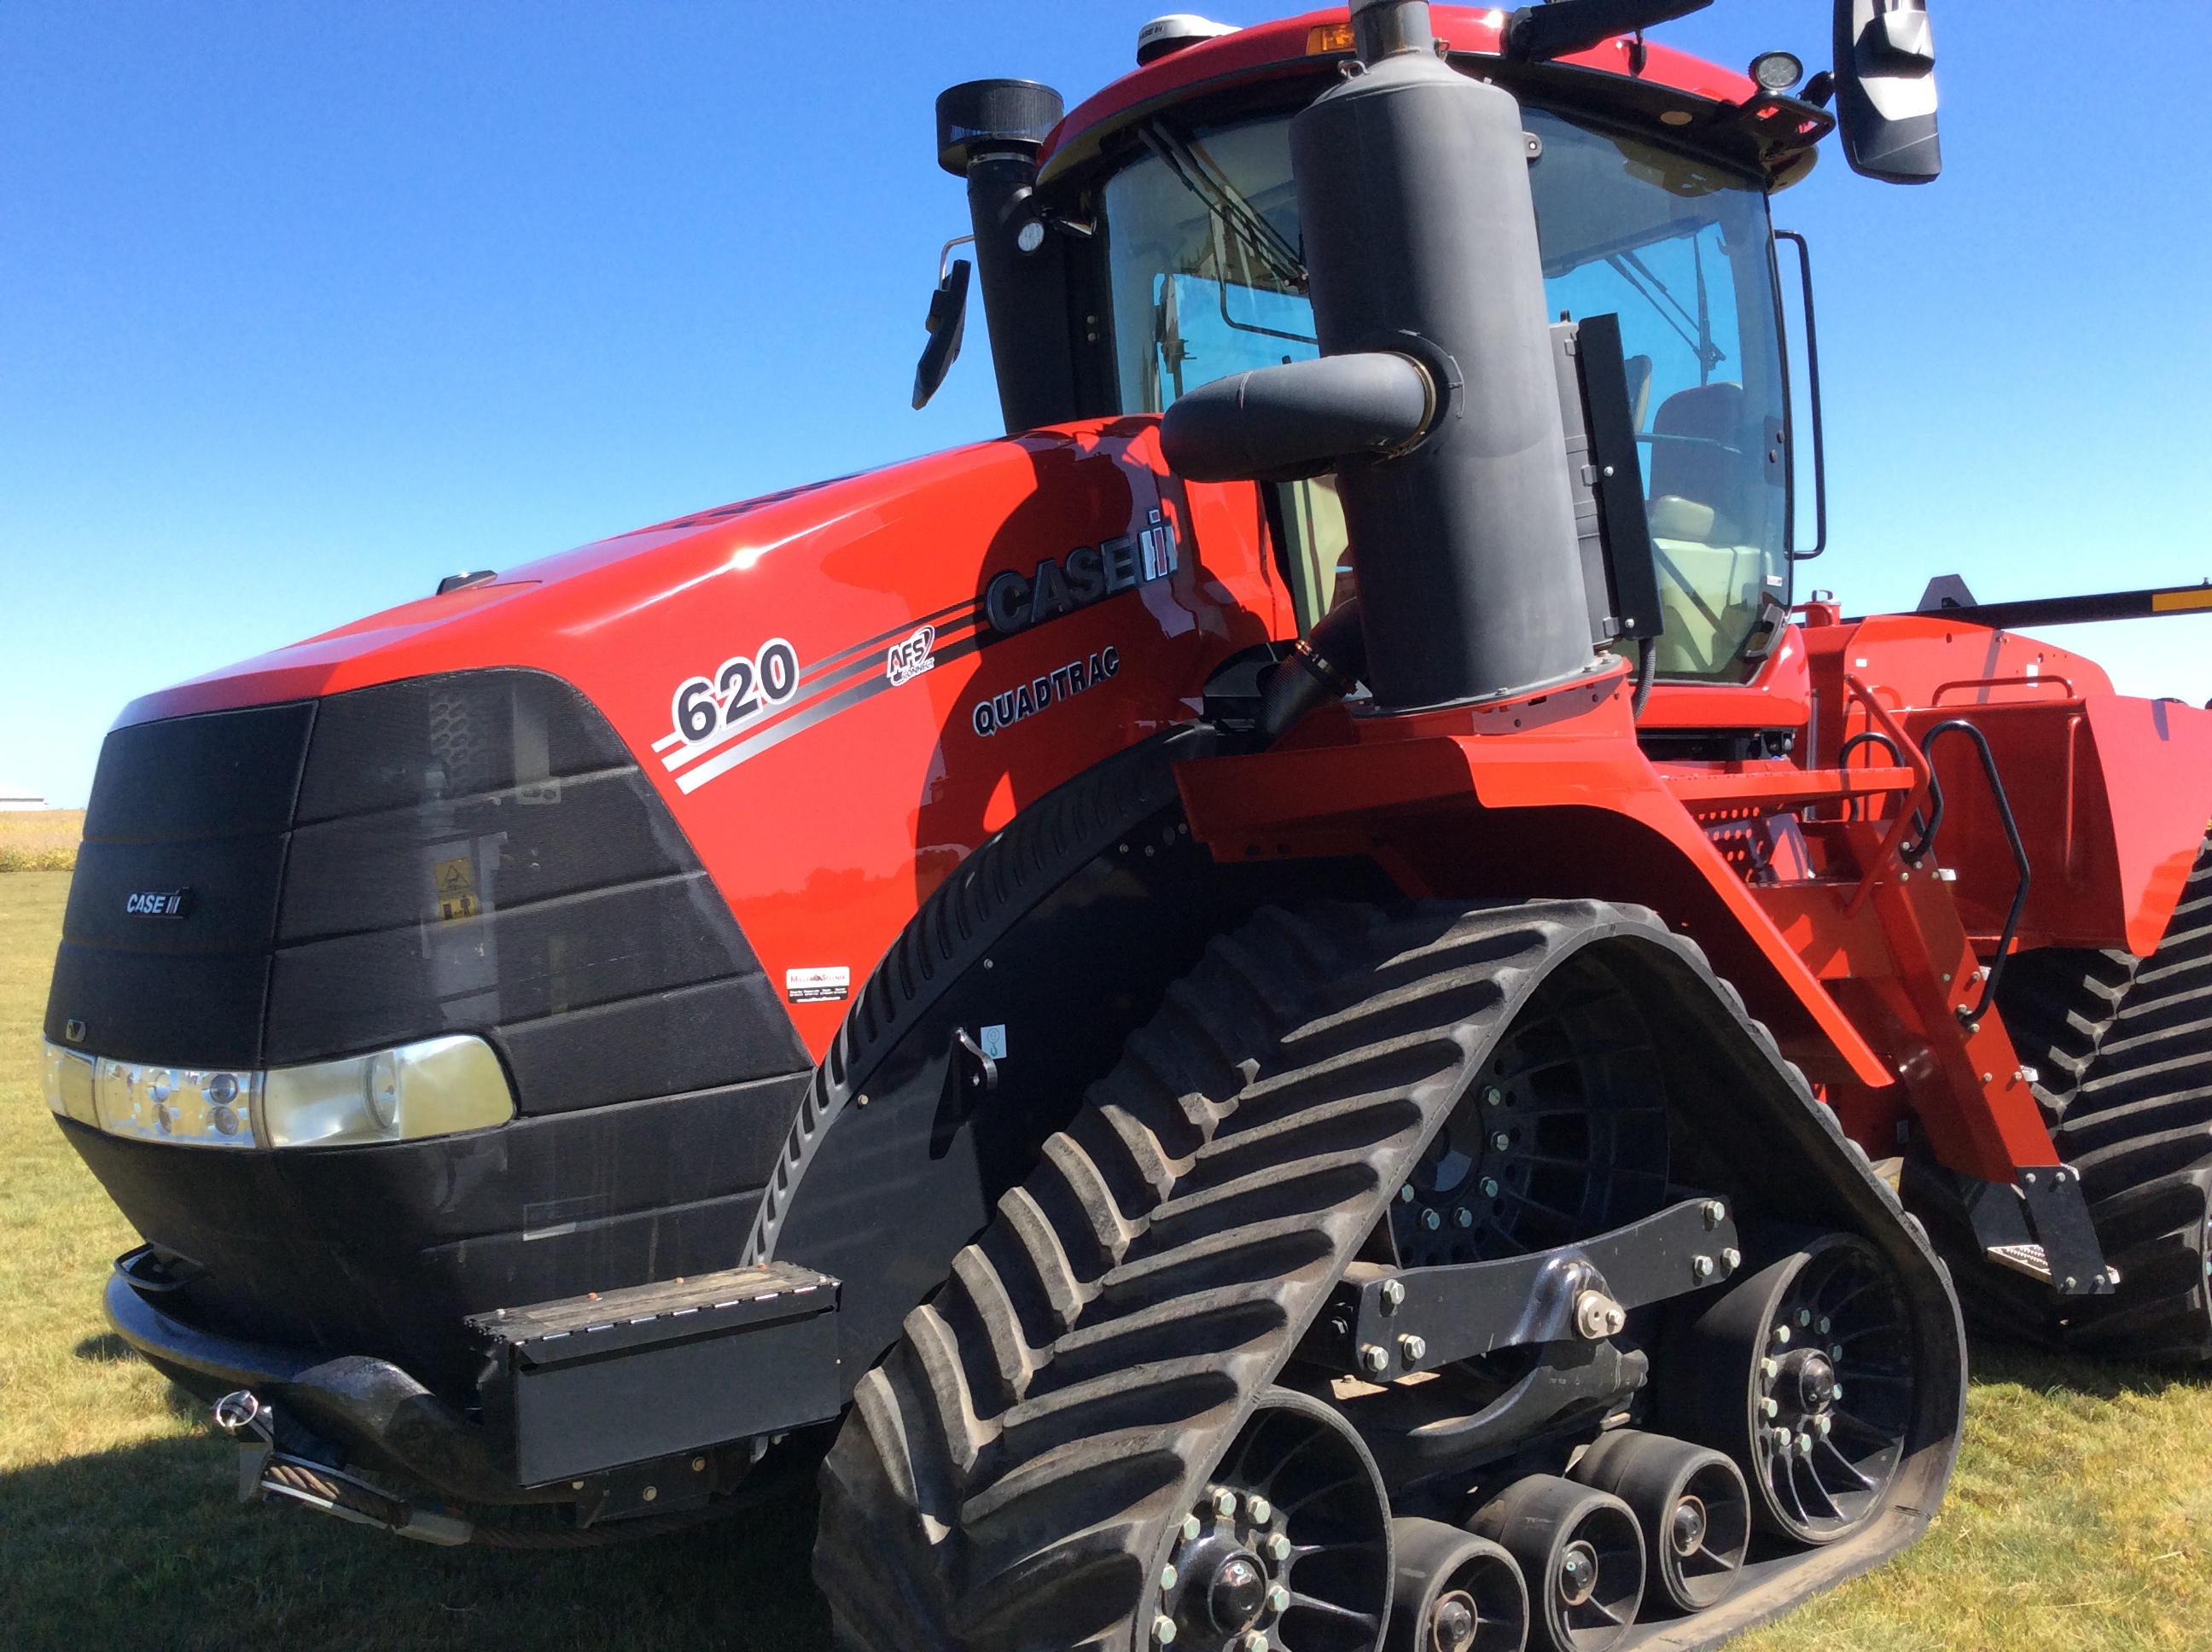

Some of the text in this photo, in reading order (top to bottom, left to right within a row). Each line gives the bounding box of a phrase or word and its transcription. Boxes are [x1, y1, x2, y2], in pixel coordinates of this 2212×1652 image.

[986, 537, 1137, 634] CASE
[672, 637, 800, 746] 620
[889, 637, 925, 674] AFS
[973, 646, 1121, 737] QUADTRAC
[126, 893, 166, 914] CASE
